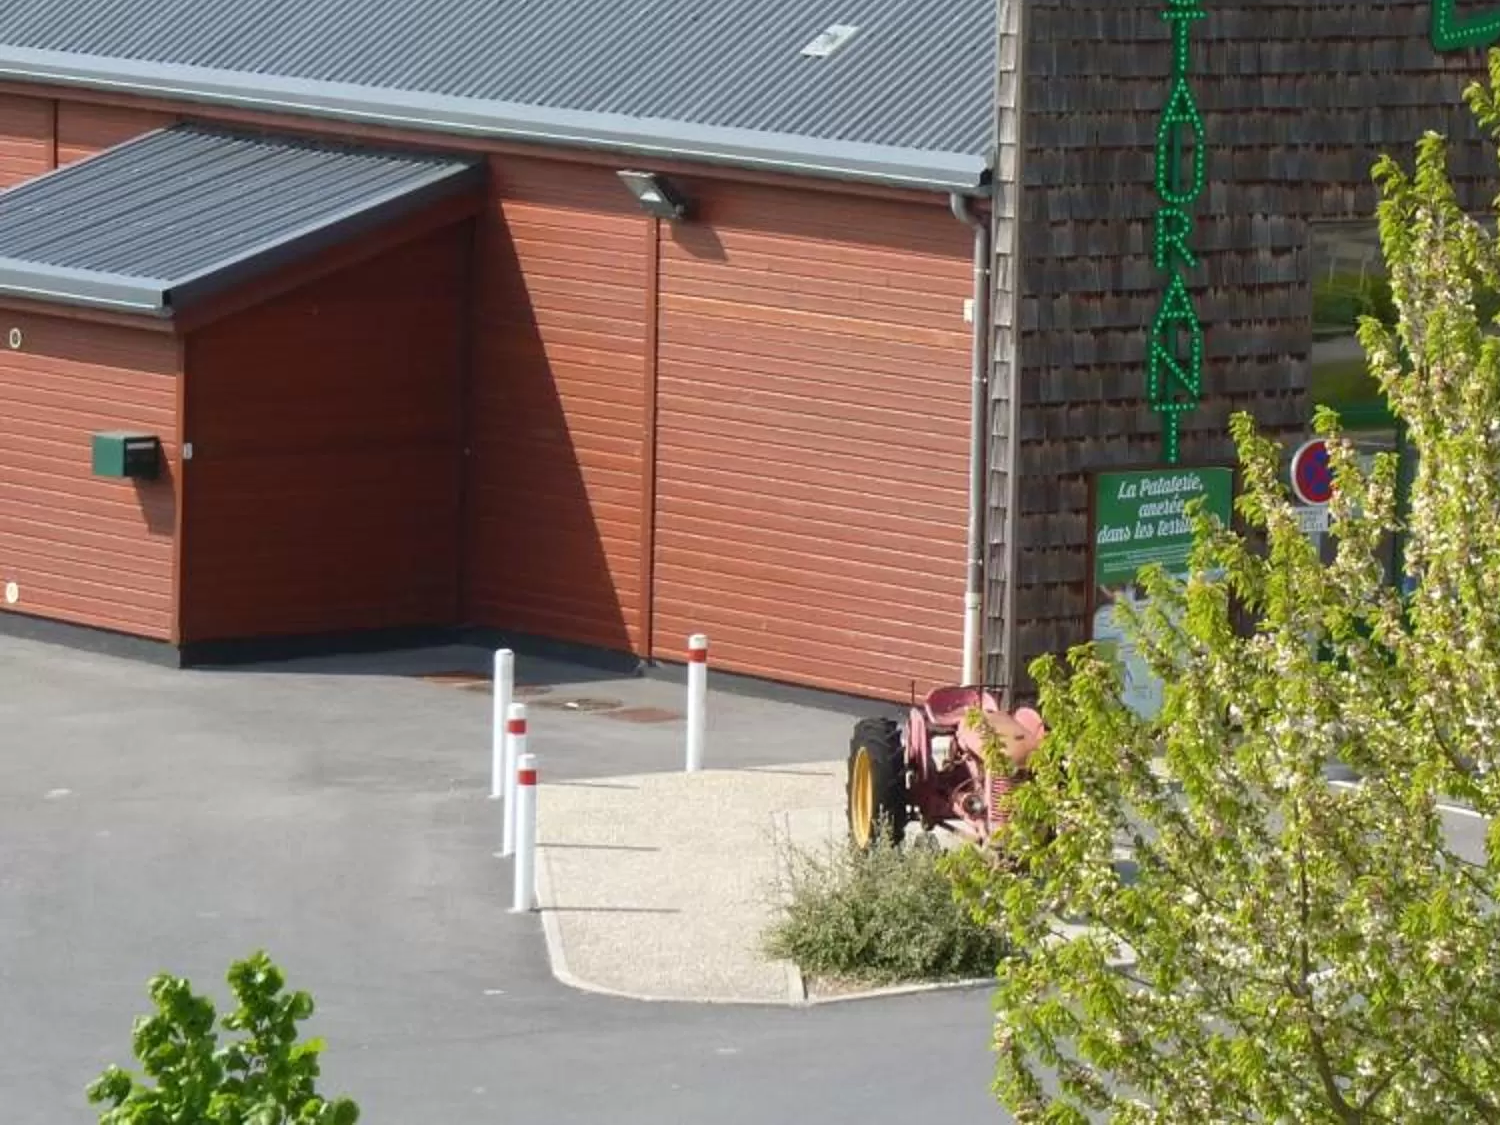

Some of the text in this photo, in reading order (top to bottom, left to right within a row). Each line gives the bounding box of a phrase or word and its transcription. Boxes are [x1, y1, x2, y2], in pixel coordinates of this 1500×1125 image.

[1117, 481, 1137, 500] La
[1097, 525, 1131, 544] dans
[1134, 520, 1155, 540] les
